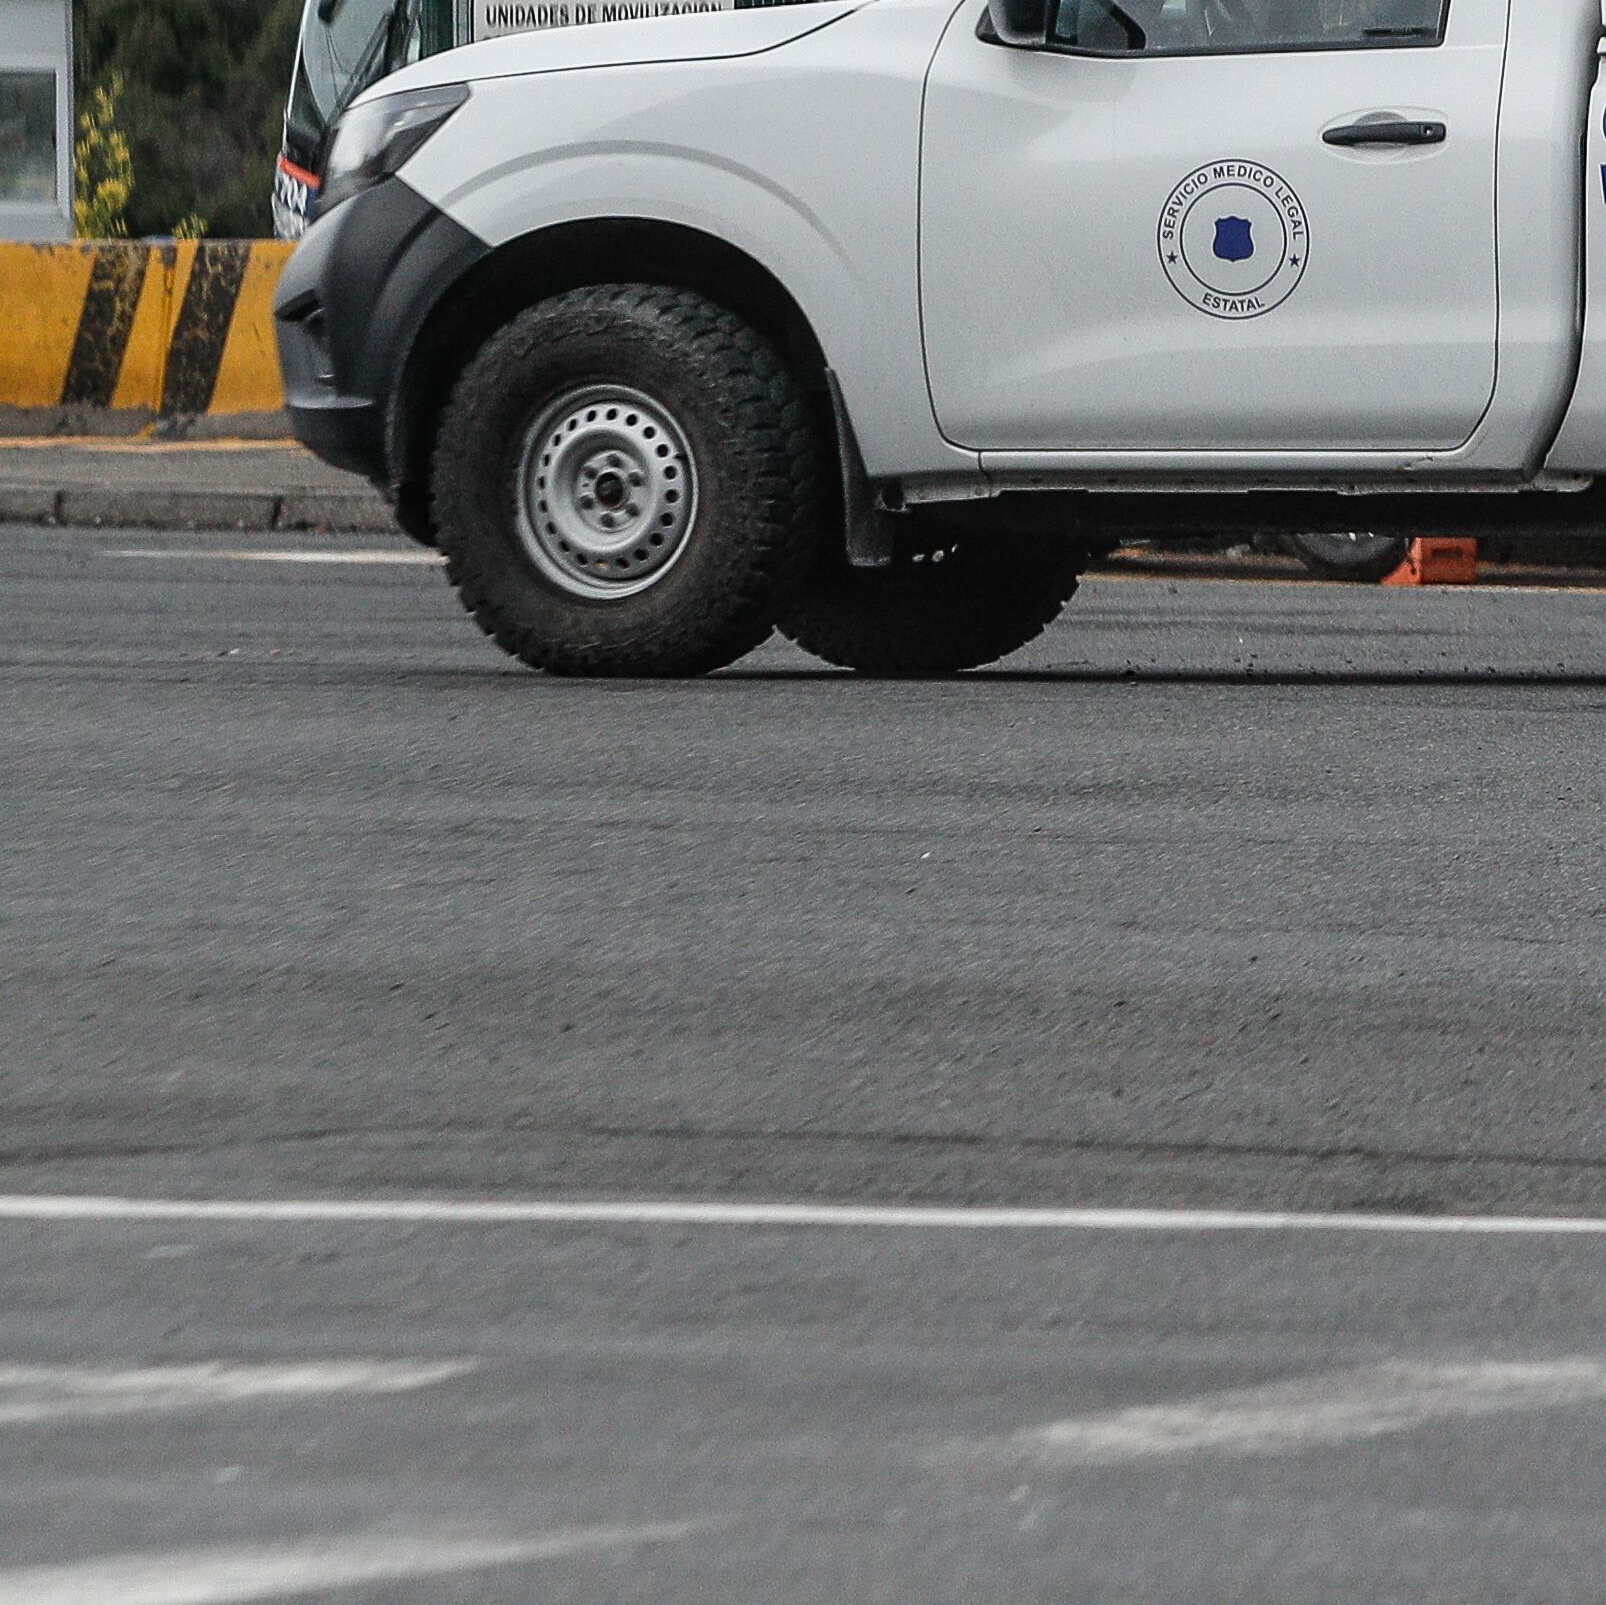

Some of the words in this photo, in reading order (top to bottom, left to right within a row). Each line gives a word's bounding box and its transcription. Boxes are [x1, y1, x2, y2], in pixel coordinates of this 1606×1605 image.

[486, 4, 569, 27] UNIDADES
[575, 4, 598, 25] DE
[1162, 172, 1208, 241] SERVICIO
[1213, 164, 1275, 189] MEDICO
[1275, 186, 1304, 241] LEGAL
[1202, 292, 1265, 313] ESTATAL
